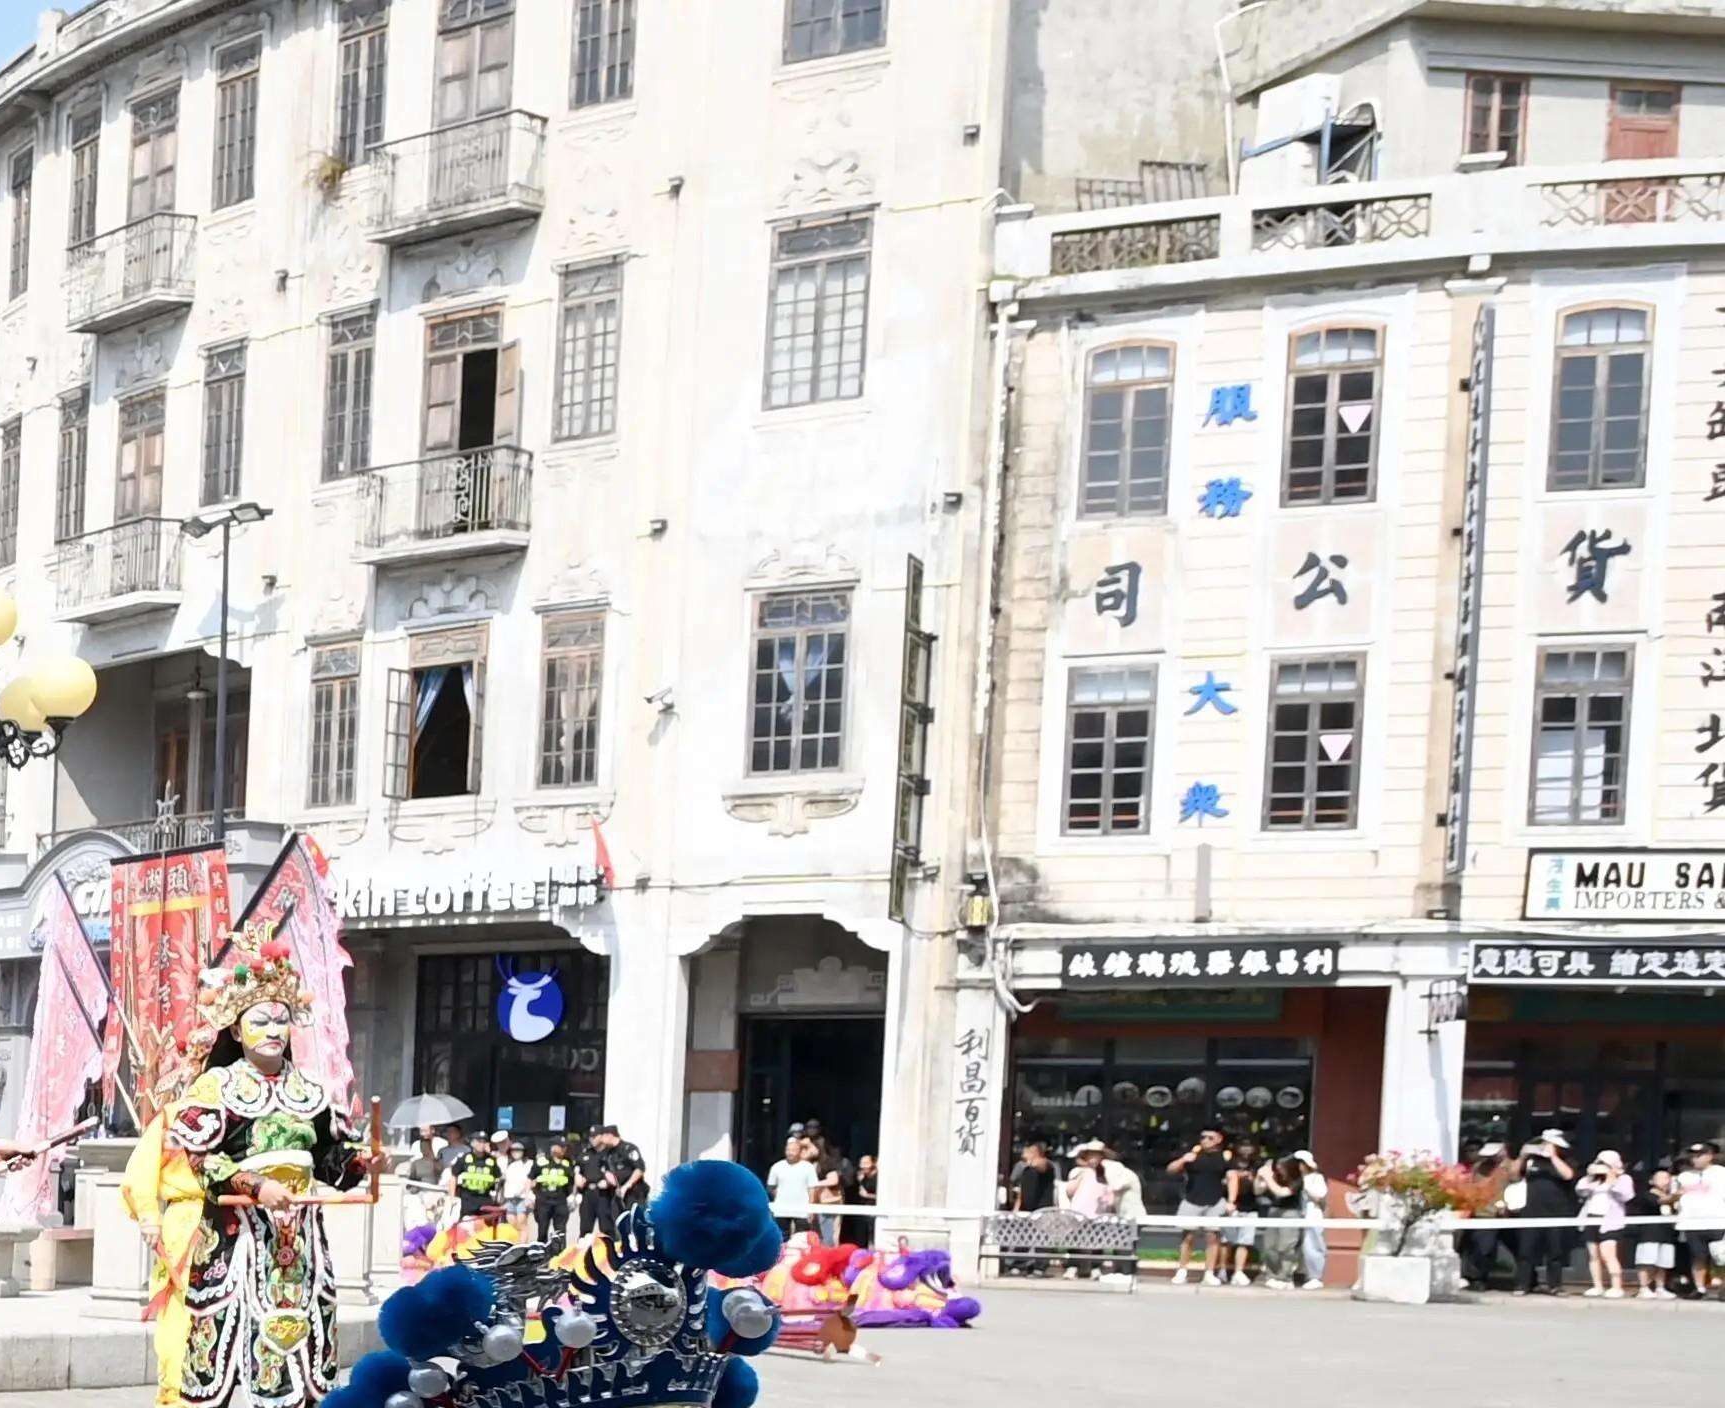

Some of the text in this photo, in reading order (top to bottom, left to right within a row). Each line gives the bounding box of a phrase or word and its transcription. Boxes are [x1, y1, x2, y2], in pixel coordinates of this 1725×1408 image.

[406, 870, 536, 915] coffee
[1575, 862, 1725, 890] MAU SA
[1574, 891, 1705, 910] IMPORTERS
[954, 1027, 990, 1157] 利昌百貨
